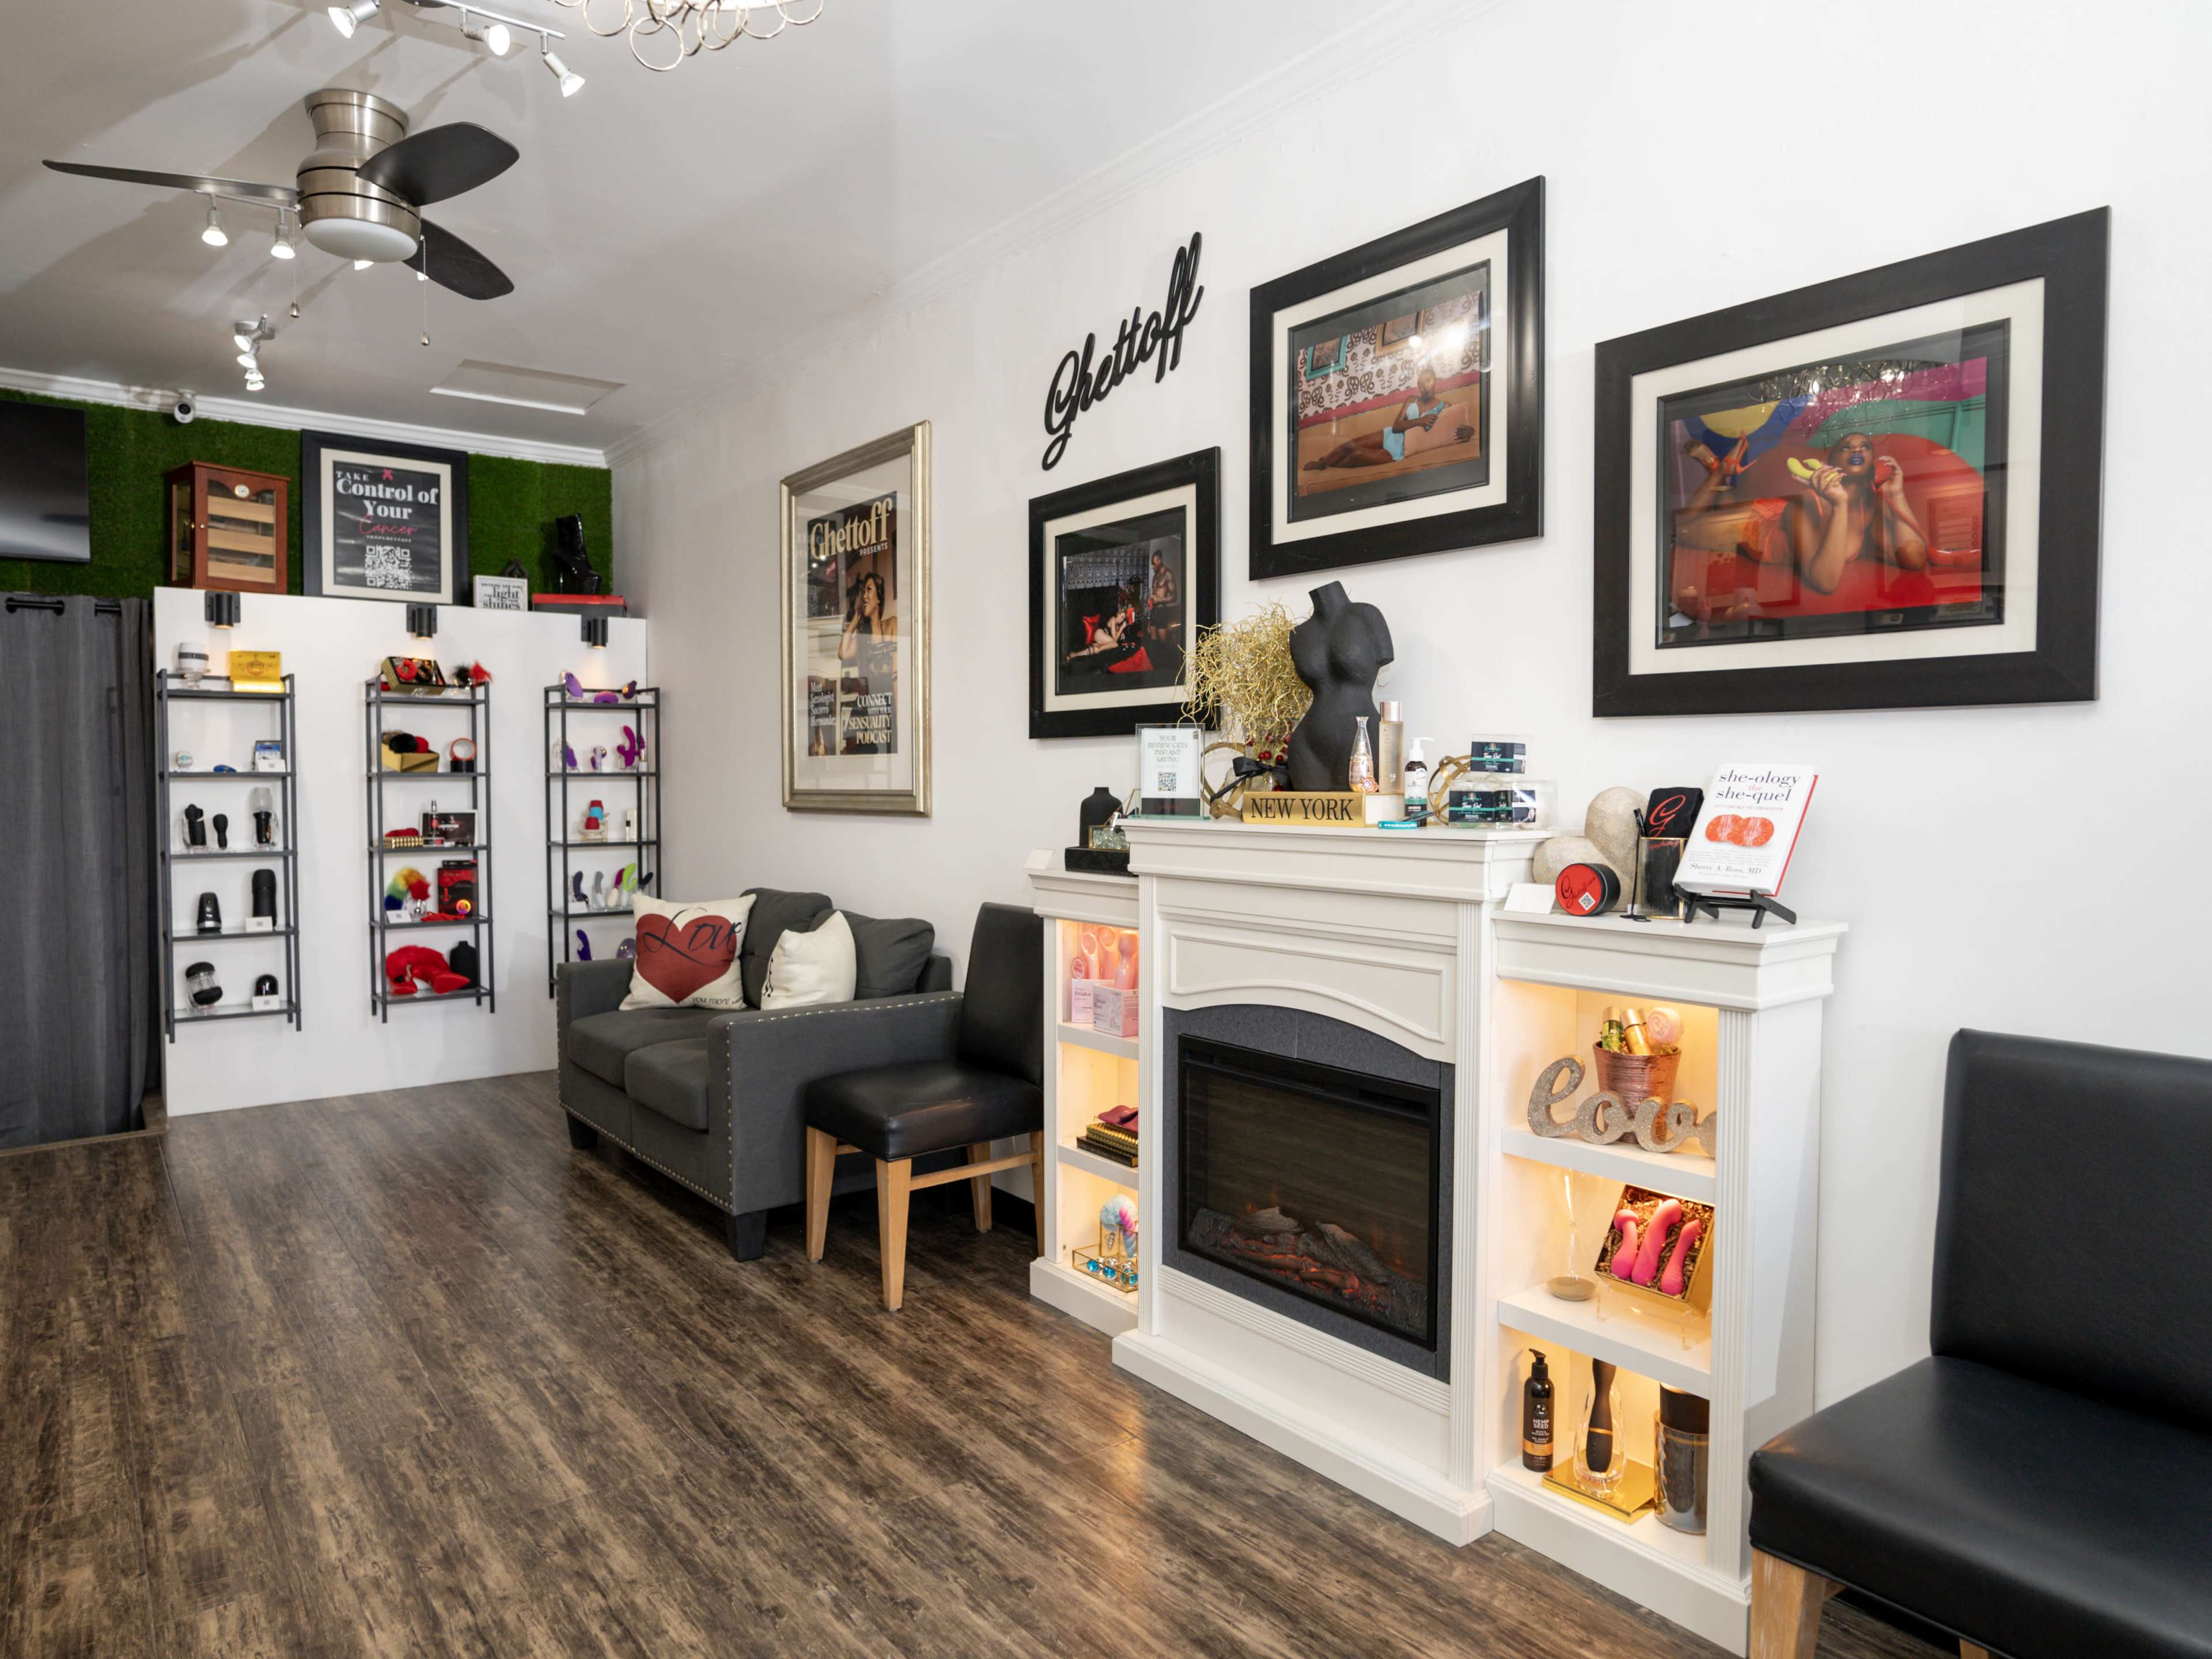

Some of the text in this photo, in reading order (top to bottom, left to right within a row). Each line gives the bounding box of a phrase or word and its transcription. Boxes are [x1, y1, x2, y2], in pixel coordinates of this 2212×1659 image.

[1042, 232, 1204, 471] Ghettoff
[335, 470, 369, 482] TAKE
[336, 478, 438, 505] Control of
[363, 500, 412, 519] Your
[359, 514, 419, 536] Cancer
[810, 497, 893, 560] Ghettoff
[859, 543, 888, 556] PRESENTS
[494, 586, 518, 602] light
[483, 598, 521, 610] shines
[857, 692, 893, 707] CONNECT
[849, 715, 891, 729] SENSUALITY
[857, 730, 892, 744] PODCAST
[1719, 770, 1801, 788] she-ology
[1715, 786, 1791, 804] she-quel
[1251, 798, 1354, 821] NEW YORK
[1690, 863, 1713, 871] Sherry
[643, 907, 742, 968] Love
